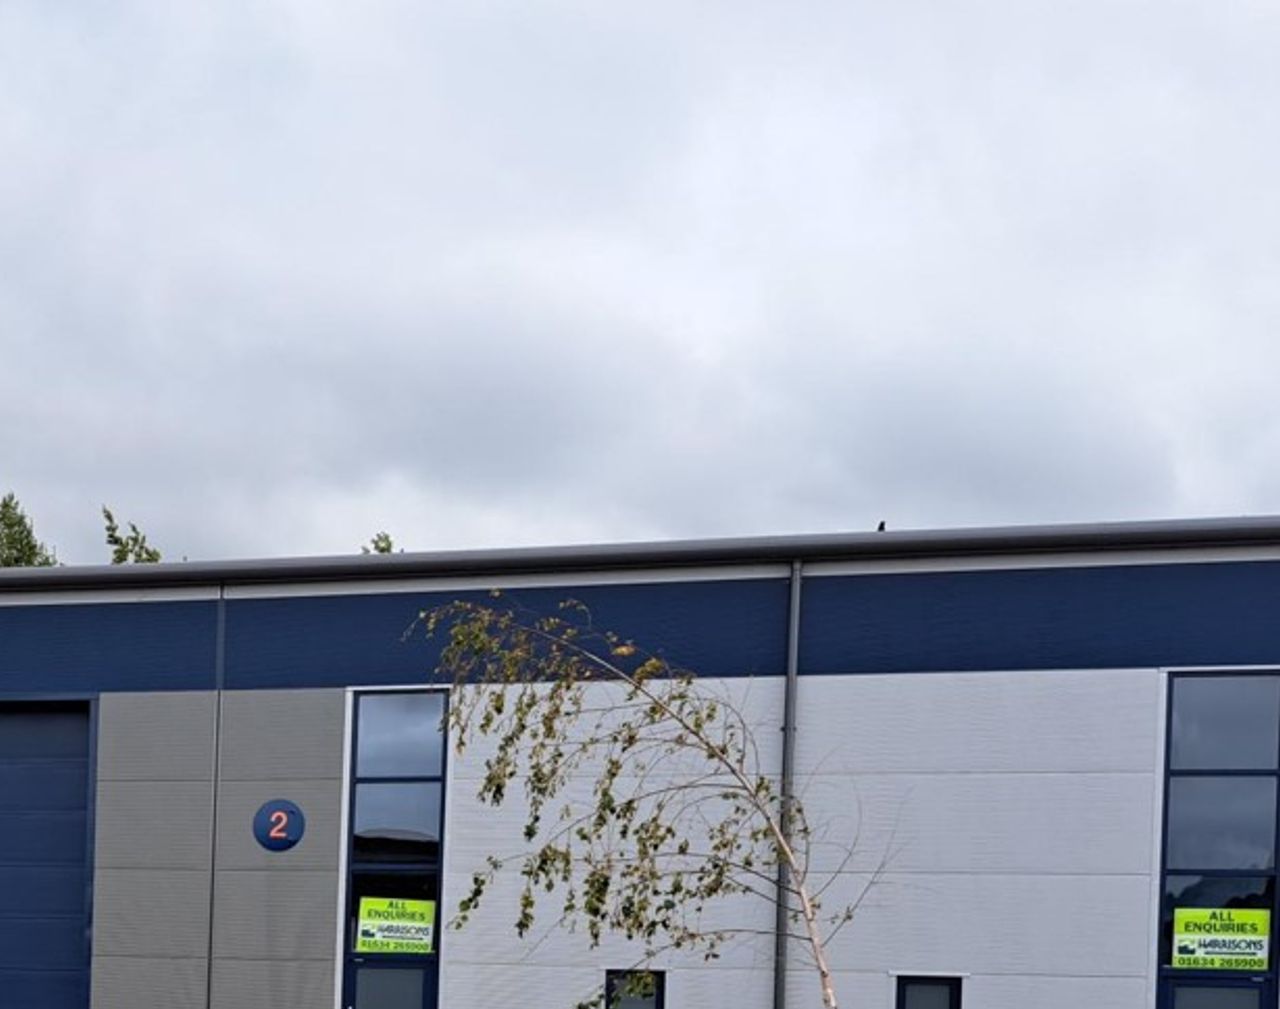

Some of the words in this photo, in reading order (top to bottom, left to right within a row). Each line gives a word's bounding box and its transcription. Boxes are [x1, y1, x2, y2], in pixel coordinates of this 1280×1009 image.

[269, 811, 288, 838] 2
[387, 900, 407, 910] ALL
[367, 908, 426, 921] ENQUIRIES
[1209, 911, 1235, 922] ALL
[1184, 921, 1259, 934] ENQUIRIES
[1198, 938, 1265, 951] HARRISONS
[1178, 957, 1215, 967] 01634
[1219, 958, 1265, 969] 265900
